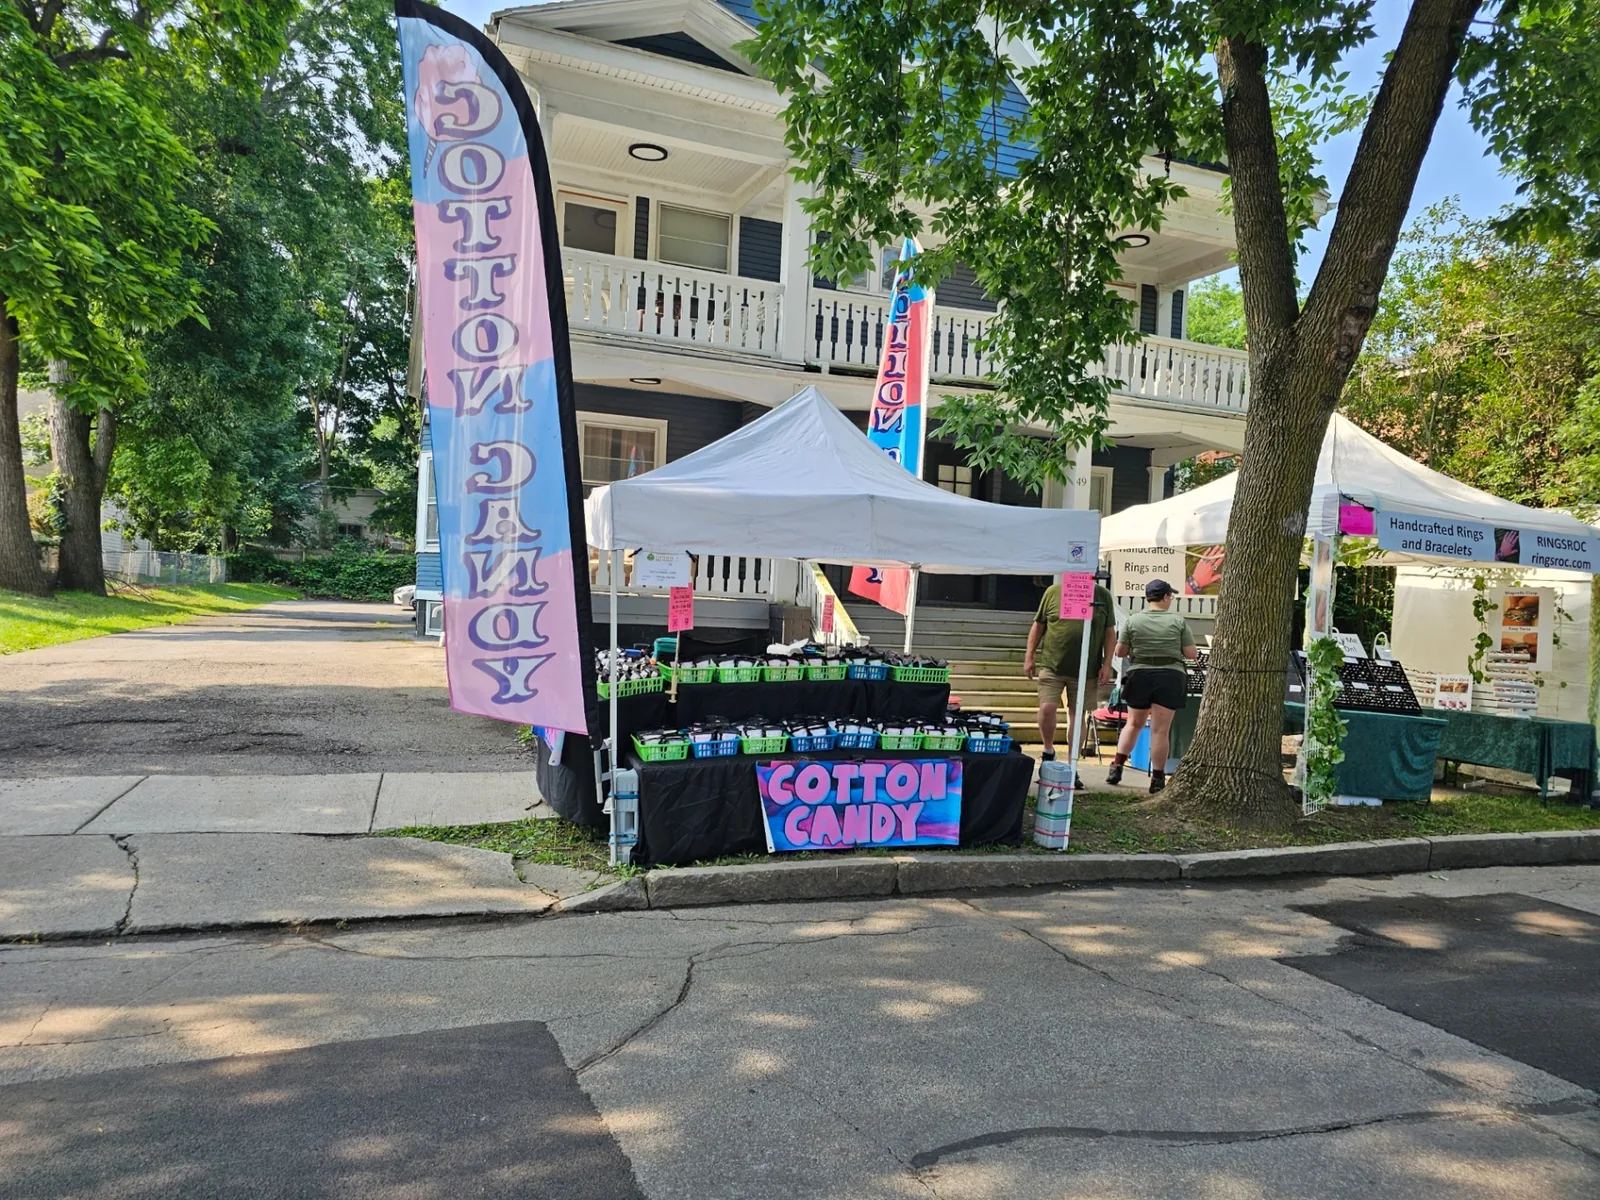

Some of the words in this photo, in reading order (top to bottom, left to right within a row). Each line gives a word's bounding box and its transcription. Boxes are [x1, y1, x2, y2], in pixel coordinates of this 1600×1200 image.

[1076, 476, 1087, 487] 49
[1389, 516, 1454, 536] Handcrafted
[1456, 525, 1484, 541] Rings
[1401, 538, 1422, 551] and
[1424, 539, 1473, 557] Bracelets
[1536, 536, 1587, 553] RINGSROC
[1124, 562, 1149, 574] Rings
[1152, 563, 1169, 573] and
[1531, 553, 1591, 570] ringsroc.com
[768, 762, 948, 806] COTTON
[784, 801, 925, 847] CANDY
